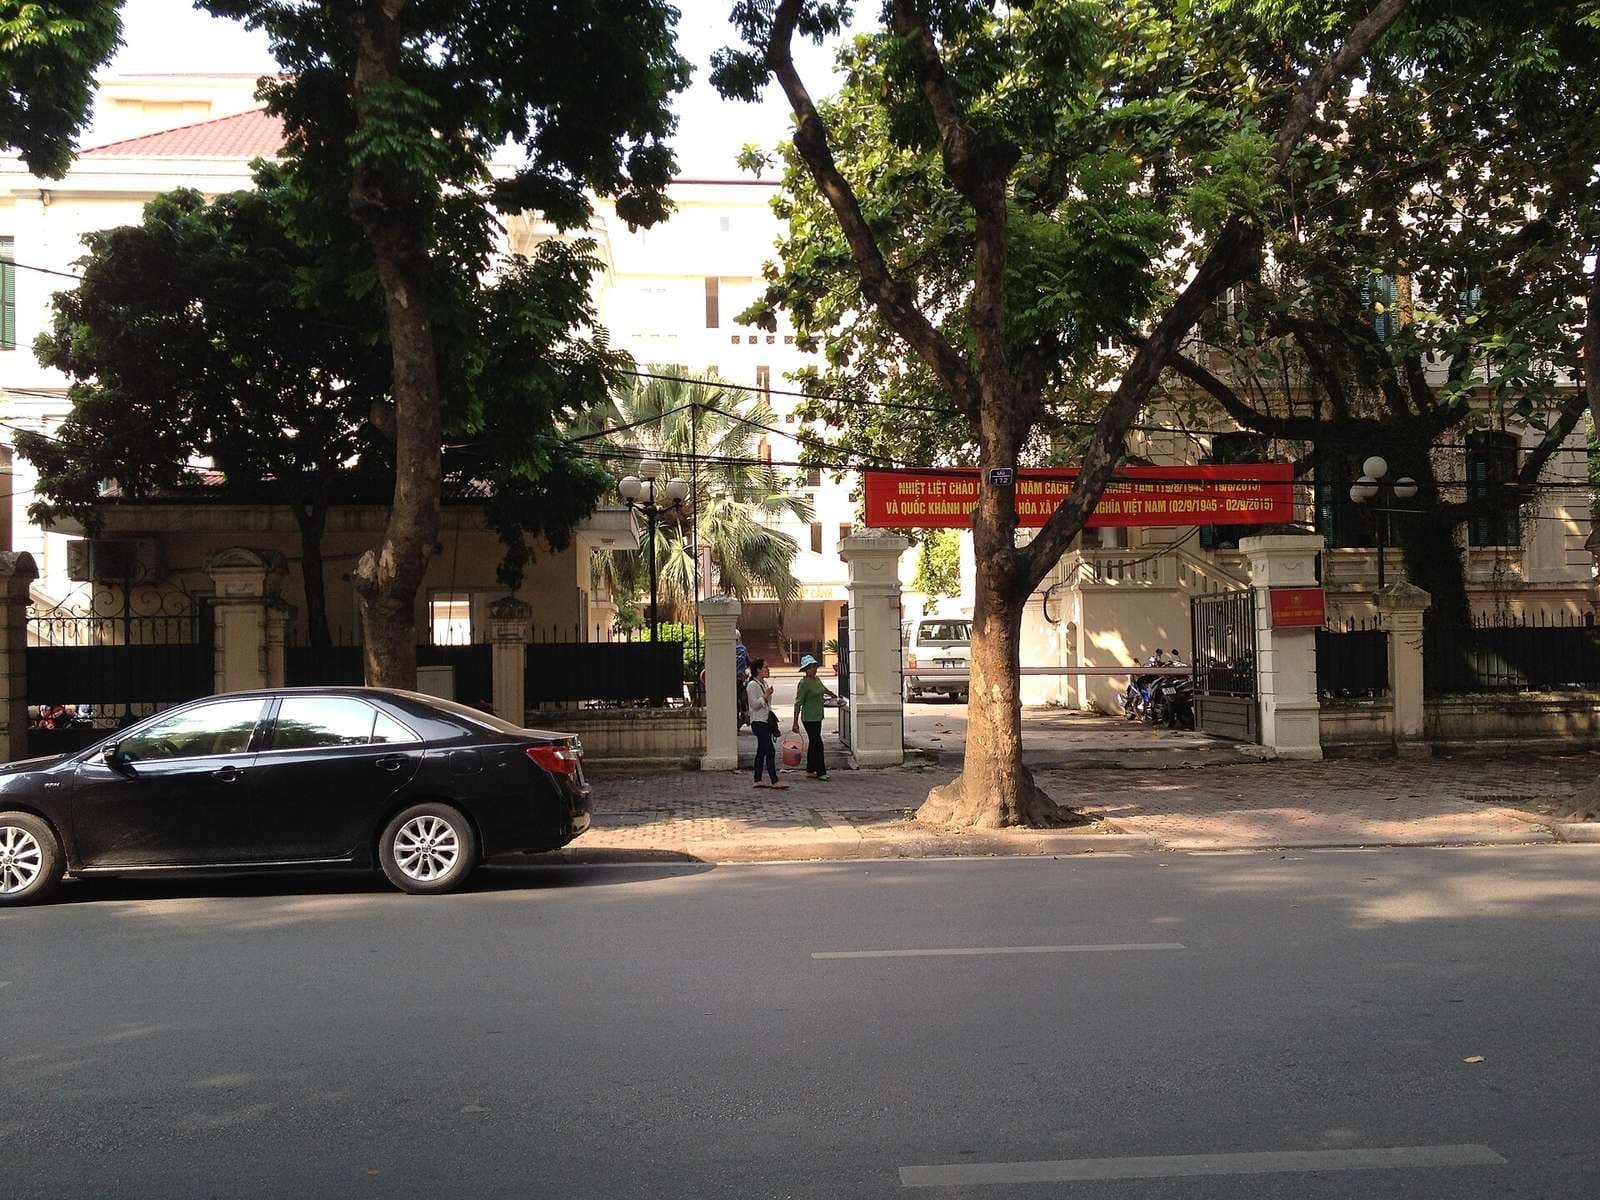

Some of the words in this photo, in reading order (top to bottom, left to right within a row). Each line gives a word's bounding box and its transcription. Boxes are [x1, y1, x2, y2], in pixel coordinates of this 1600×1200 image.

[898, 479, 925, 497] NHIỆT
[928, 479, 946, 497] LIỆT
[949, 479, 974, 495] CHÀO
[1021, 480, 1042, 495] NĂM
[886, 499, 898, 515] VÀ
[901, 497, 926, 515] QUỐC
[928, 499, 960, 515] KHÁNH
[1018, 499, 1037, 514] HÒA
[1039, 499, 1052, 514] XÃ
[1123, 498, 1142, 516] VIỆT
[1144, 500, 1166, 513] NAM
[1169, 499, 1217, 513] (02/9/1945
[1226, 498, 1273, 512] 02/9/2015)
